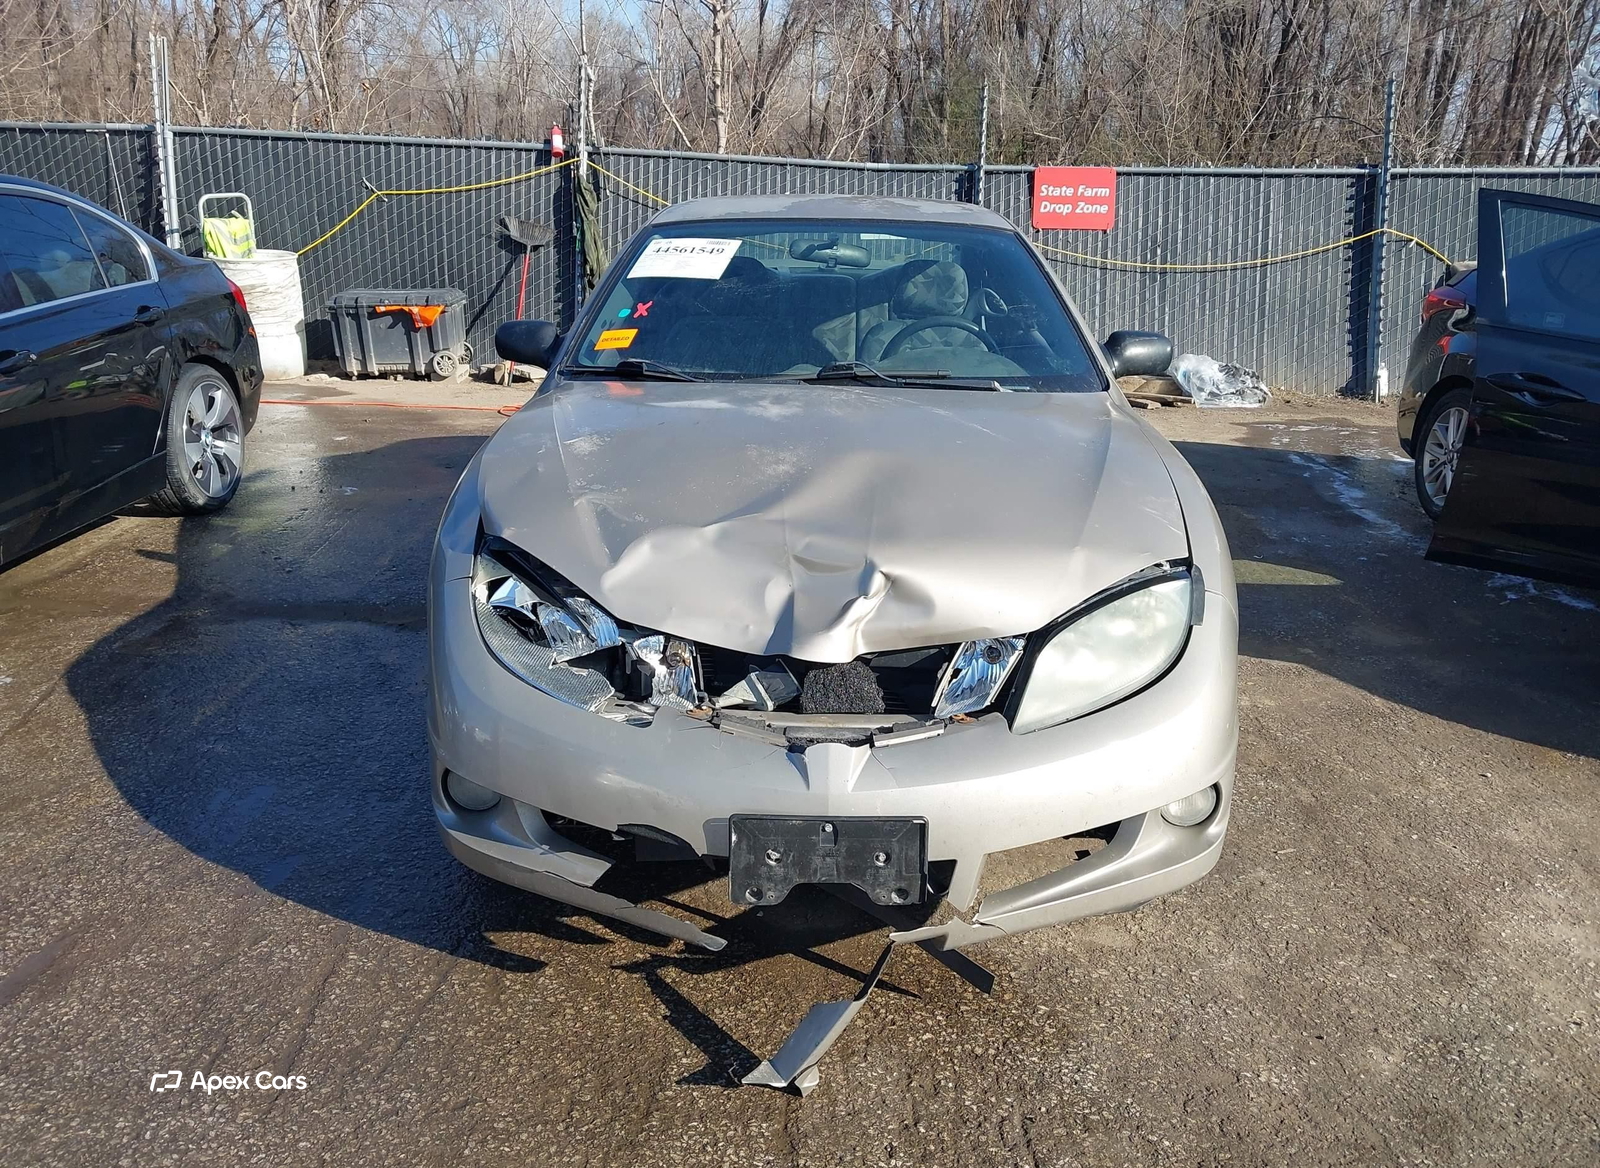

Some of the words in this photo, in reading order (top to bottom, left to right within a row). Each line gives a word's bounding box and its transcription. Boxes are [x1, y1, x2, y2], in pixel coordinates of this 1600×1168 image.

[1040, 184, 1075, 197] State
[1077, 185, 1110, 197] Farm
[1040, 201, 1073, 216] Drop
[1075, 202, 1109, 214] Zone
[652, 246, 725, 255] 44561549
